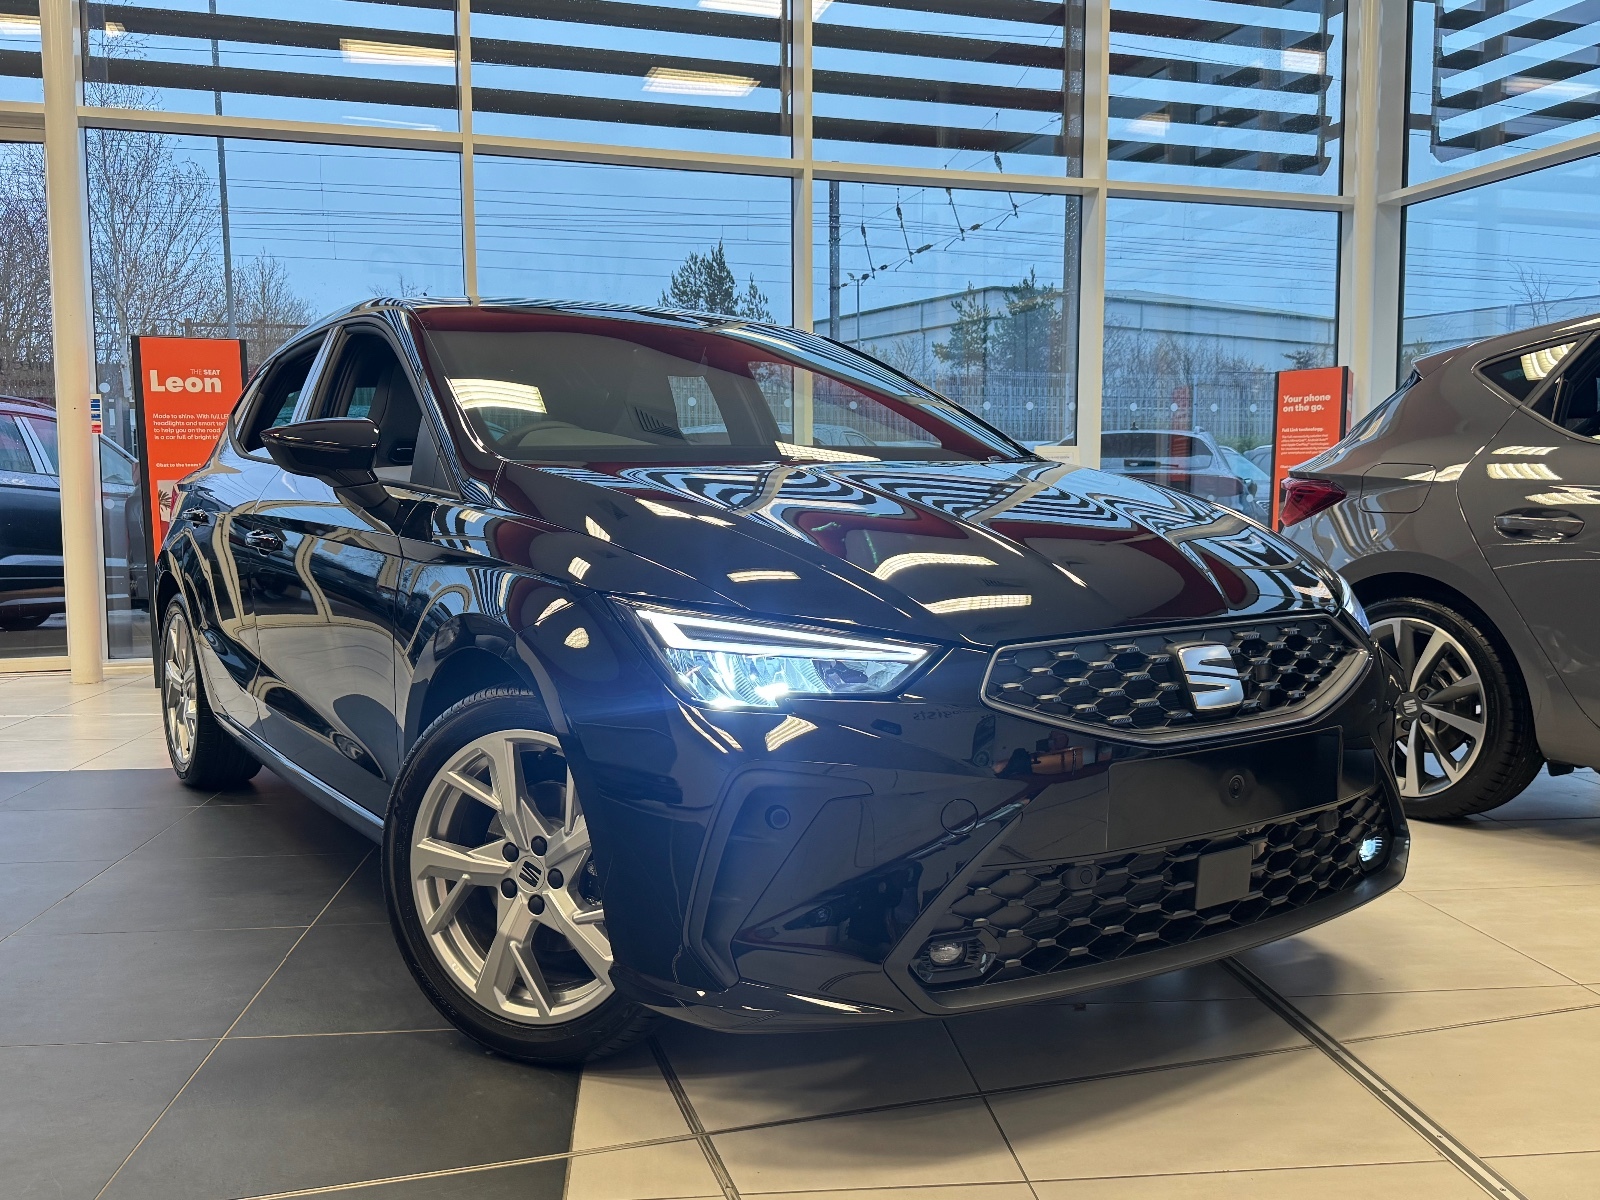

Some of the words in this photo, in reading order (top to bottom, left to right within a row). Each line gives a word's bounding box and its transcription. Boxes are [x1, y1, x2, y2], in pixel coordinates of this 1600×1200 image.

[149, 369, 222, 393] Leon
[1282, 395, 1303, 404] Your
[1304, 394, 1331, 404] phone
[1294, 404, 1310, 412] the
[1310, 404, 1324, 412] go.
